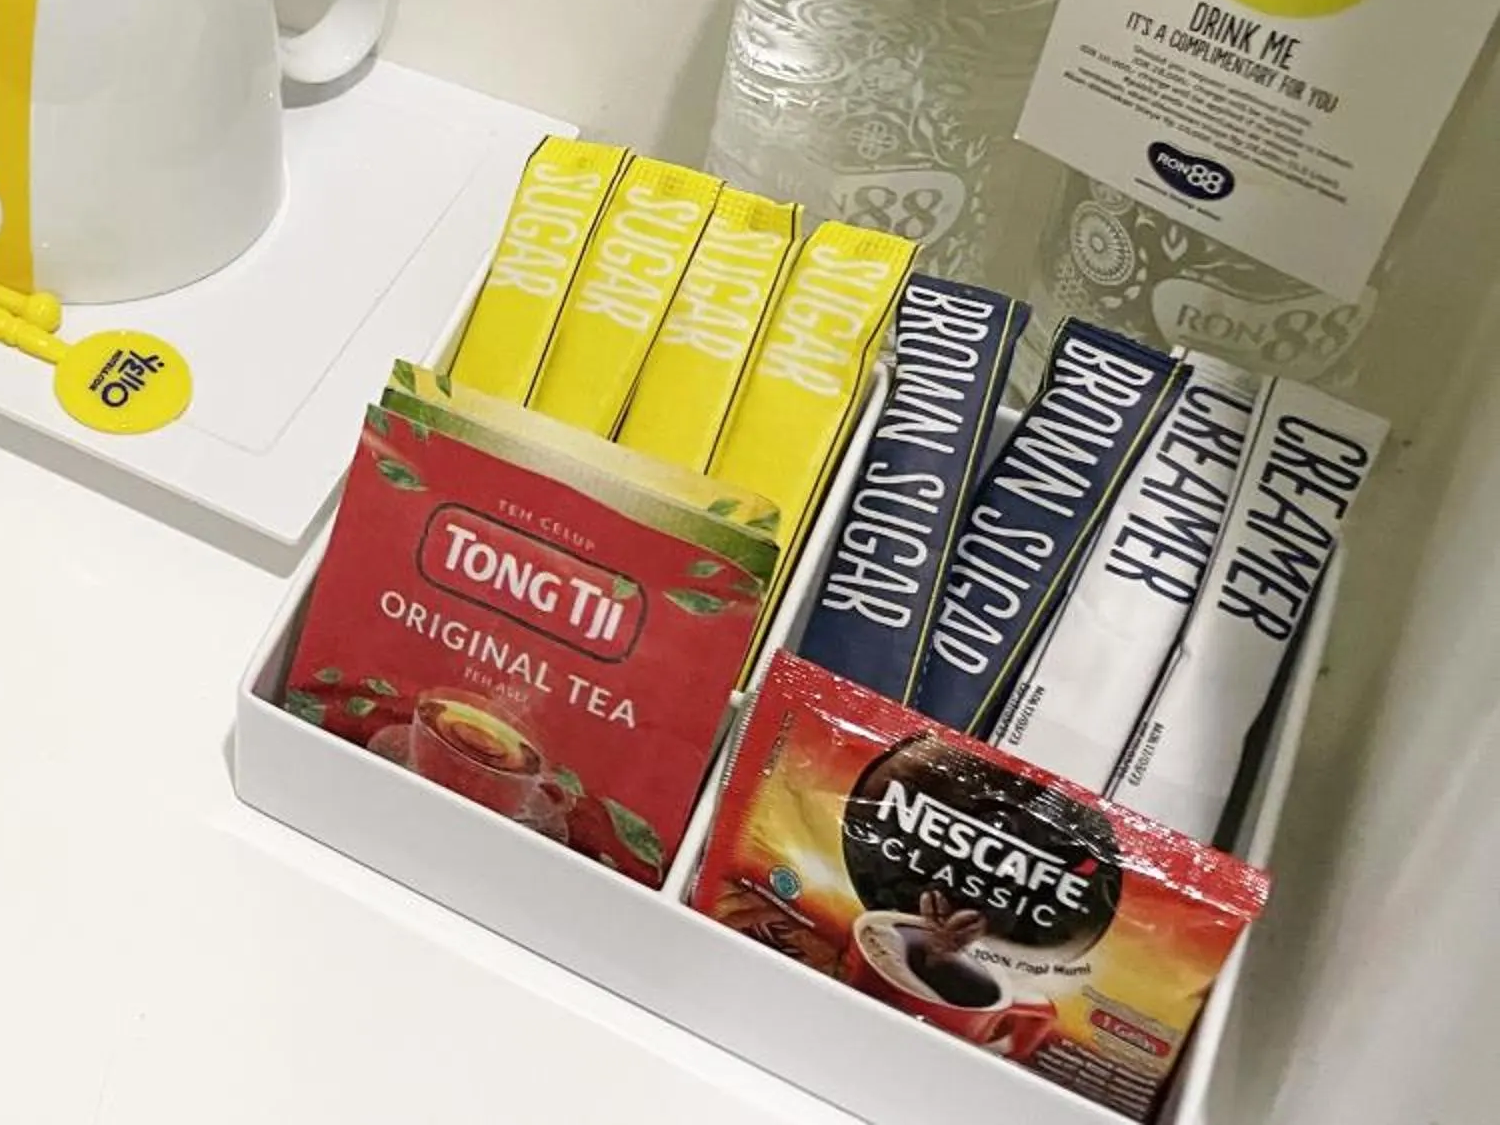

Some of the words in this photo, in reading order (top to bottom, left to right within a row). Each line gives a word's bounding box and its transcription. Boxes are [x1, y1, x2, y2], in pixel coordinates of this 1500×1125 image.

[1125, 11, 1154, 36] IT'S
[1153, 24, 1168, 44] A
[1169, 29, 1281, 88] COMPLIMENTARY
[1278, 75, 1307, 101] FOR
[1308, 86, 1340, 114] YOU
[1188, 1, 1261, 54] DRINK
[1259, 29, 1301, 71] ME
[487, 162, 601, 298] SUGAR
[573, 186, 700, 332] SUGAR
[661, 217, 784, 361] SUGAR
[757, 244, 890, 397] SUGAR
[875, 283, 996, 456] BROWN
[993, 337, 1154, 519] BROWN
[1104, 385, 1253, 606] CREAMER
[443, 522, 563, 614] TONG
[568, 576, 626, 643] TJI
[499, 499, 534, 523] TEH
[539, 516, 596, 552] CELUP
[821, 460, 946, 629] SUGAR
[1217, 414, 1369, 643] CREAMER
[379, 590, 553, 694] ORIGINAL
[567, 673, 637, 730] TEA
[881, 837, 1057, 928] CLASSIC
[974, 948, 1012, 968] 100%
